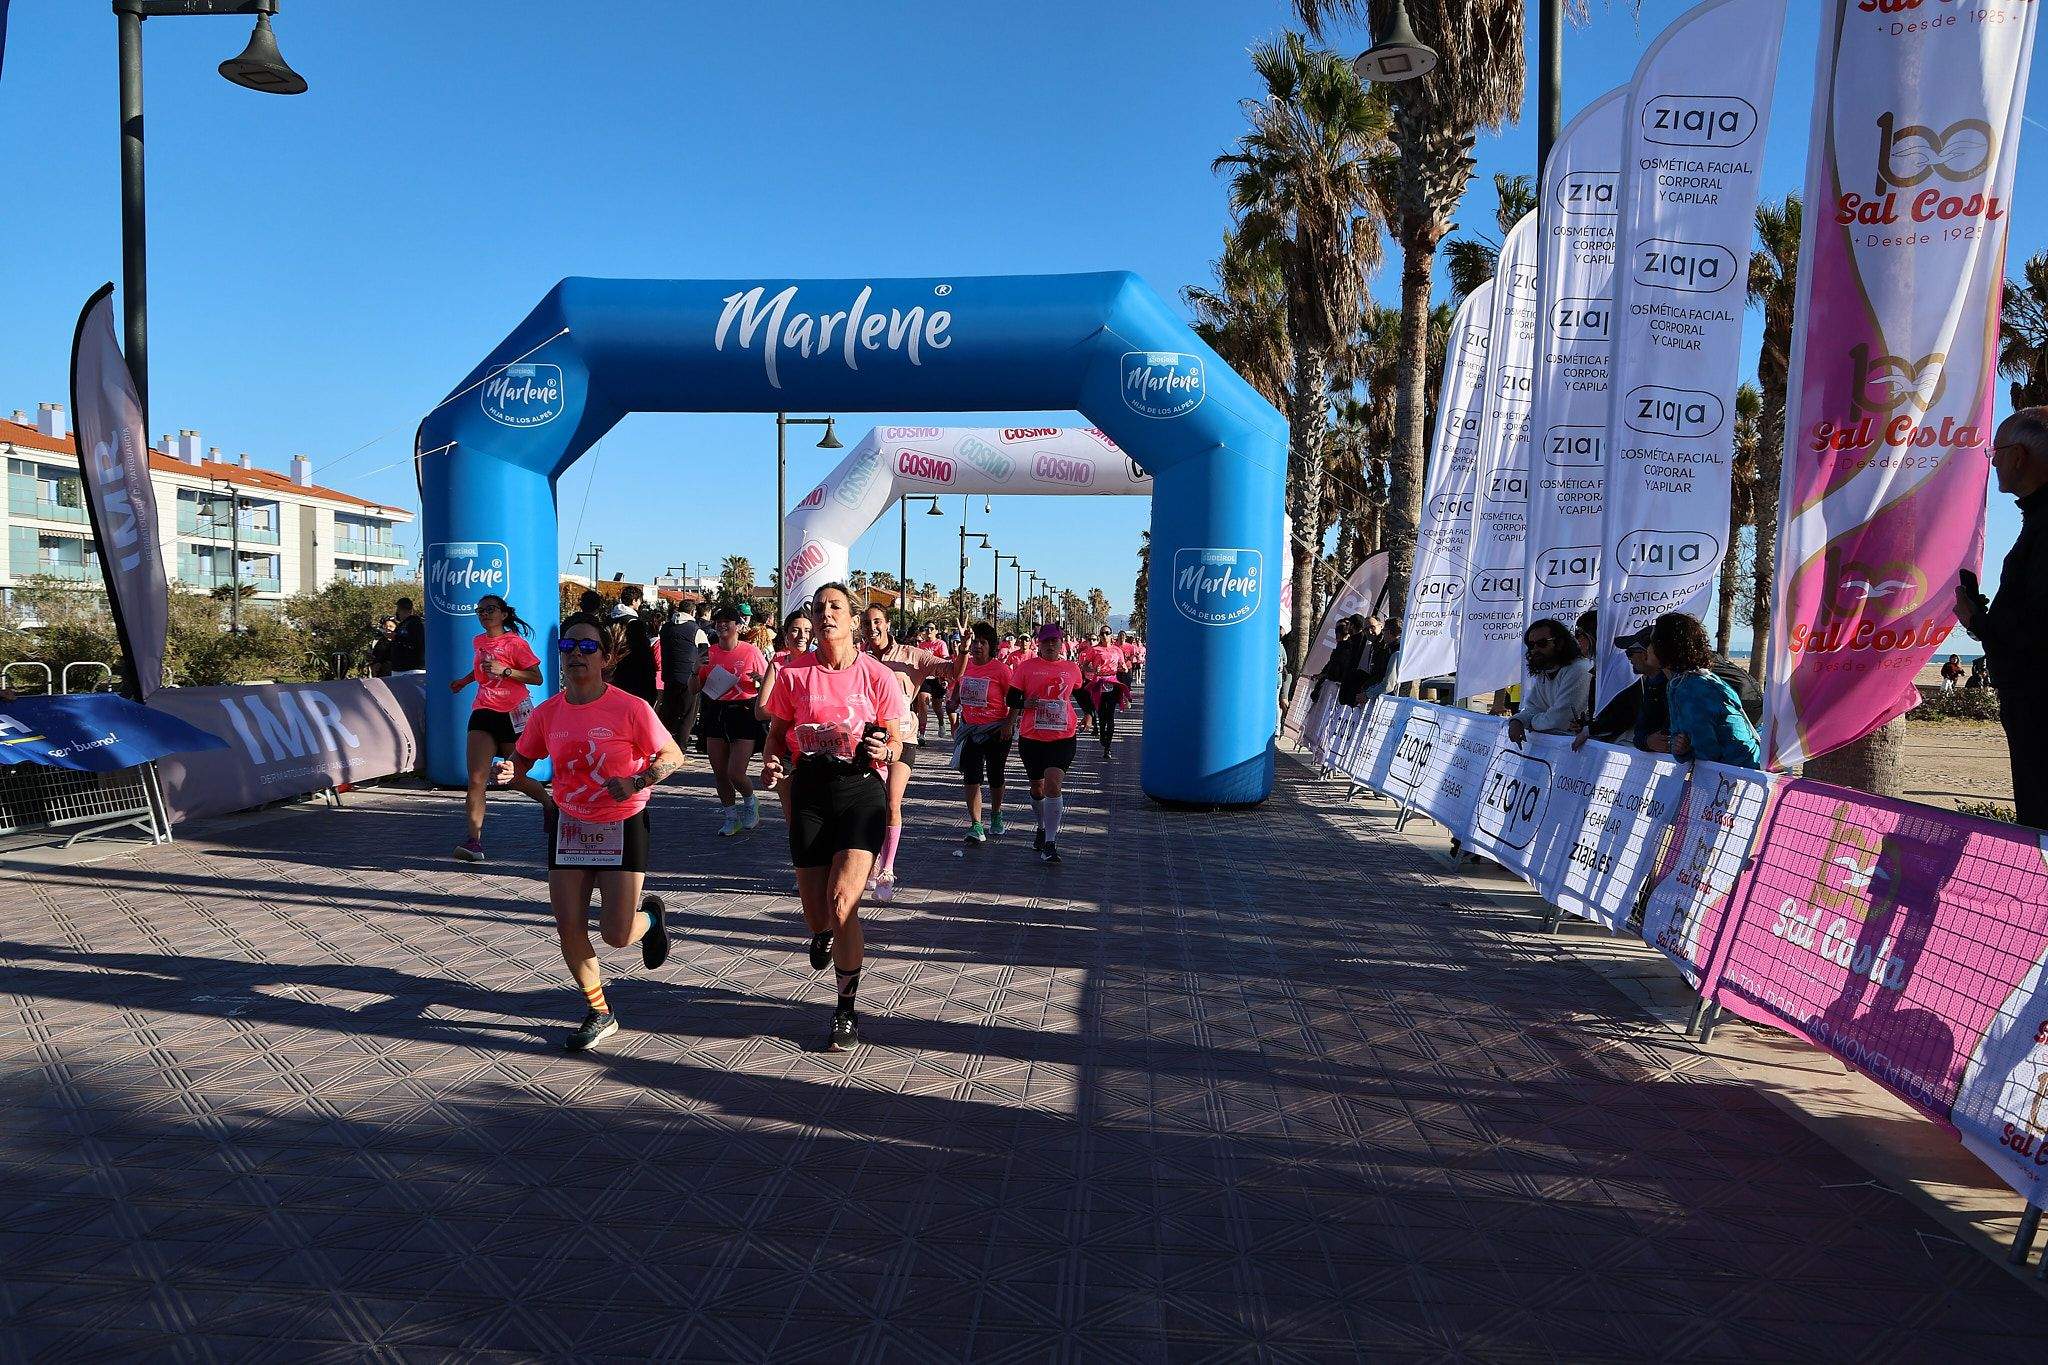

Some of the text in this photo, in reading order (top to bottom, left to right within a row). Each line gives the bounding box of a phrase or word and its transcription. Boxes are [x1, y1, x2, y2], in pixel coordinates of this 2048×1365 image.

[1891, 14, 1956, 36] Desde
[1654, 108, 1739, 140] ziaja
[1707, 161, 1753, 174] FACIAL,
[1658, 175, 1723, 190] CORPORAL
[1568, 184, 1617, 207] zia
[1659, 190, 1718, 205] Y CAPILAR
[1834, 191, 1899, 226] Sal
[1572, 240, 1616, 251] CORPO
[1866, 233, 1930, 248] Desde
[1574, 254, 1615, 264] Y CAPIL
[1643, 252, 1719, 285] ziaja
[1559, 310, 1609, 335] ziaj
[1689, 309, 1735, 322] FACIAL,
[714, 285, 952, 389] Marlene
[1650, 319, 1705, 336] CORPORAL
[1651, 334, 1701, 350] Y CAPILAR
[1127, 366, 1200, 401] Marlene
[1502, 375, 1531, 391] zia
[1564, 381, 1608, 391] Y CAPILA
[486, 377, 558, 410] Marlene
[488, 406, 503, 419] HIJA
[505, 415, 514, 423] DE
[532, 410, 553, 422] ALPES
[1173, 399, 1194, 413] ALPES
[1637, 399, 1706, 431] ziaja
[1508, 434, 1530, 442] CAPIL
[1809, 418, 1875, 453] Sal
[1552, 437, 1605, 461] ziaj
[1677, 453, 1724, 464] FACIAL,
[899, 452, 952, 481] COSMO
[1036, 455, 1090, 483] COSMO
[1644, 464, 1695, 478] COPORAL
[1841, 456, 1898, 470] Desde
[1491, 478, 1528, 498] ziaj
[1645, 480, 1692, 493] Y APILAR
[95, 430, 141, 572] IMR
[1557, 492, 1603, 502] CORPOR
[1558, 505, 1603, 515] Y CAPILA
[1492, 523, 1527, 532] CORPOR
[1498, 533, 1525, 542] CAPIL
[431, 558, 503, 596] Marlene
[1548, 557, 1599, 580] ziaj
[1179, 566, 1257, 604] Marlene
[1481, 578, 1520, 597] ziaj
[1181, 601, 1251, 621] HIJA DE LOS ALPES
[1482, 622, 1522, 631] CORPORA
[1788, 616, 1952, 654] Sal Costa
[219, 690, 361, 765] IMR
[72, 732, 121, 752] bueno!
[1486, 772, 1541, 832] ziaja
[1556, 775, 1596, 799] COSMÉTICA
[1626, 794, 1665, 819] CORPORA
[1568, 837, 1613, 875] ziaja.es
[1772, 897, 1823, 949] Sal
[1820, 916, 1906, 990] Costa
[1831, 1031, 1933, 1107] MOMENTOS
[2000, 1122, 2033, 1158] Sal
